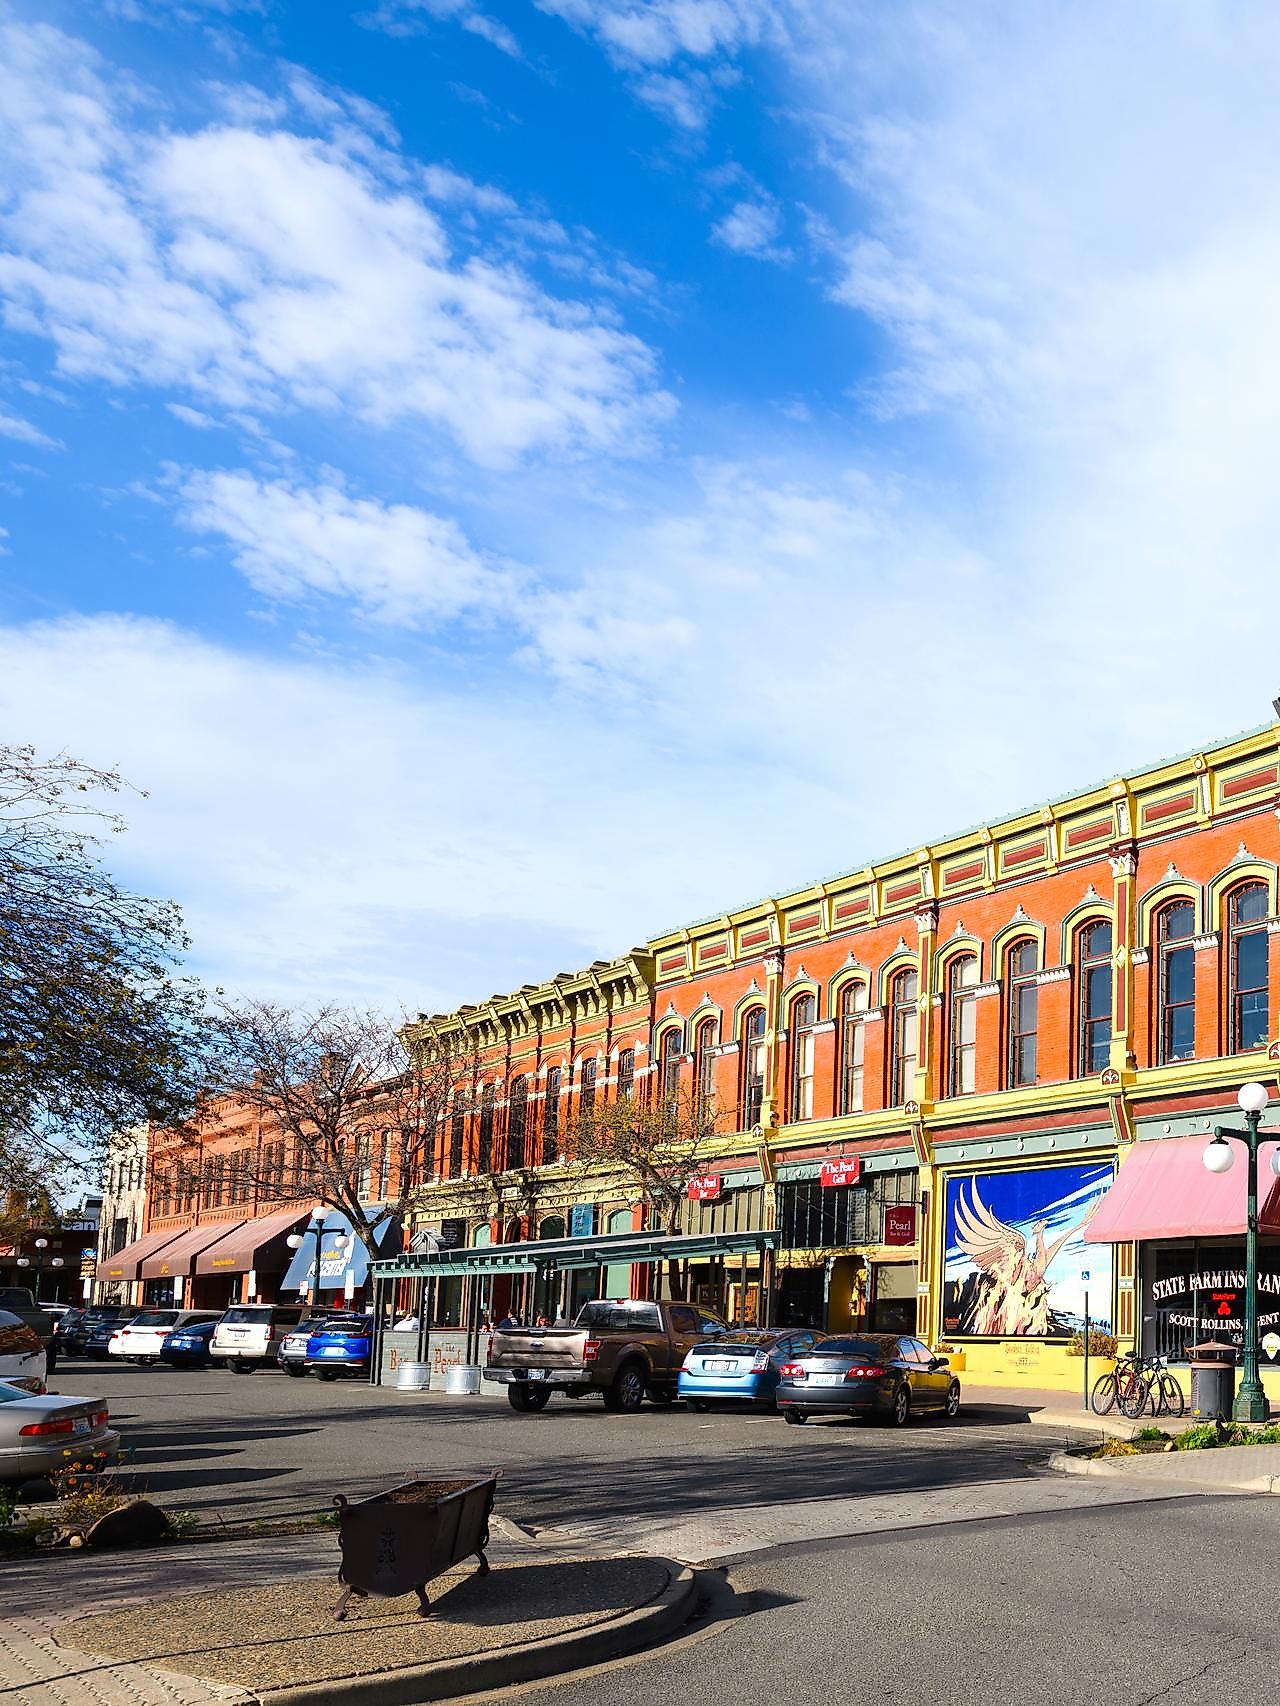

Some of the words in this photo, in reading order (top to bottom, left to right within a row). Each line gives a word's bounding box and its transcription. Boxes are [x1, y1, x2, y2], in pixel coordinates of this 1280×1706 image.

[826, 1163, 839, 1174] The
[839, 1160, 855, 1172] Pearl
[890, 1219, 911, 1231] Pearl
[1152, 1275, 1186, 1301] STATE
[1189, 1271, 1222, 1291] FARM
[1169, 1313, 1199, 1328] SCOTT
[1201, 1318, 1244, 1330] ROLLINS,
[1246, 1312, 1280, 1330] ENT
